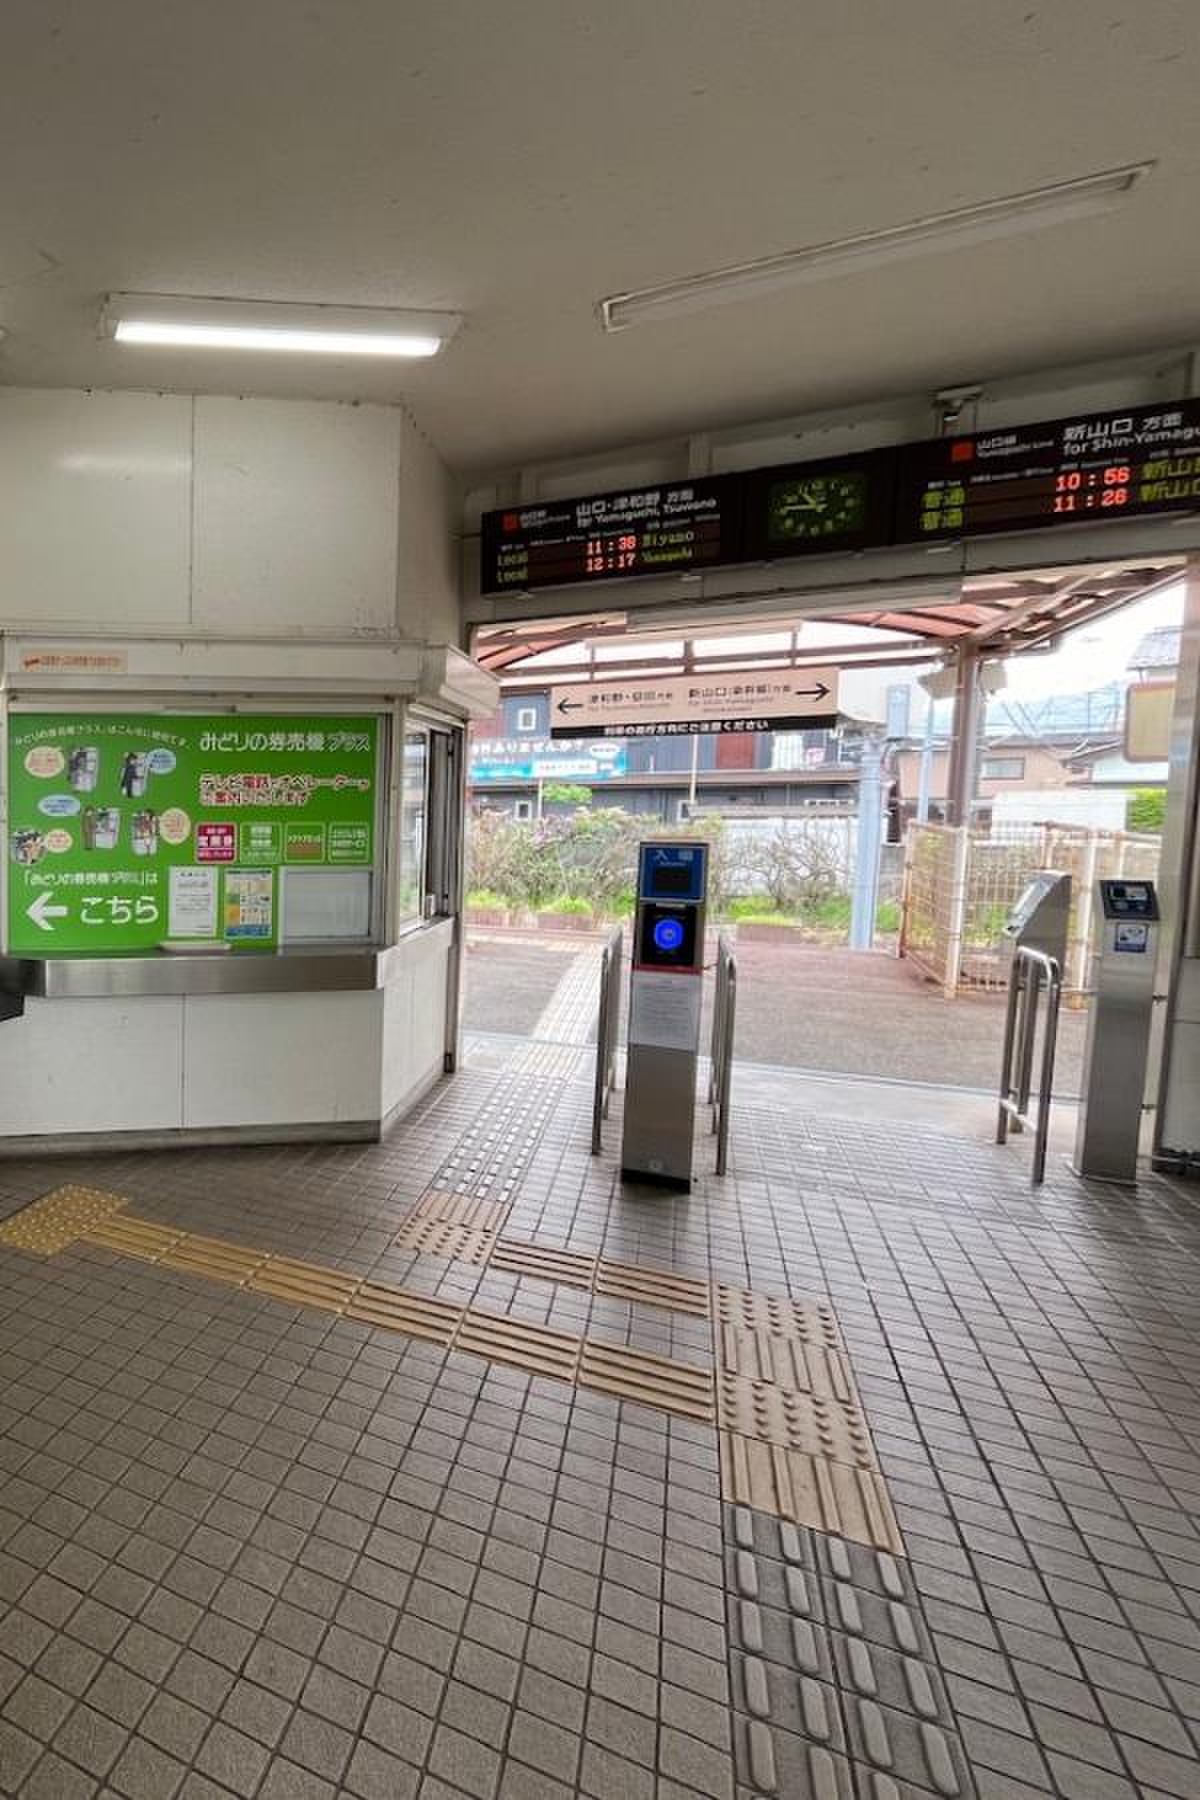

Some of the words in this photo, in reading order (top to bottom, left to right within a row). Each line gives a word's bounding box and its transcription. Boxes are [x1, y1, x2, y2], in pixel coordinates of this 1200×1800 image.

[1063, 417, 1132, 441] 新山口
[1063, 441, 1088, 456] for
[1055, 466, 1129, 492] 10:56
[585, 552, 636, 572] 12:17
[81, 895, 159, 924] こちら
